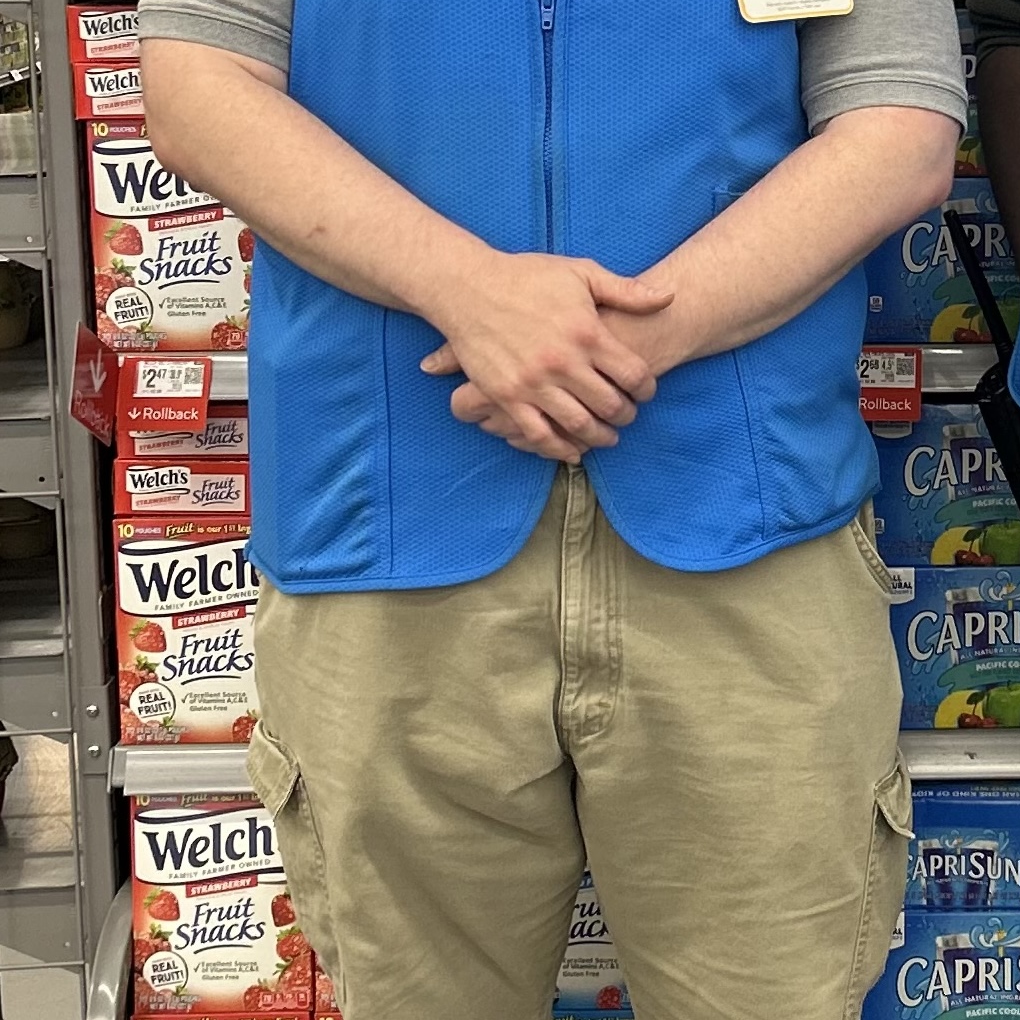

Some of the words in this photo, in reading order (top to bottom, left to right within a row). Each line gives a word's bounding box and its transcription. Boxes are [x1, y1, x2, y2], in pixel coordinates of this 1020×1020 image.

[91, 122, 108, 137] 10
[154, 211, 217, 229] STRAWBERRY
[155, 231, 221, 262] Fruit
[138, 253, 233, 285] Snacks
[115, 296, 143, 309] REAL
[114, 308, 149, 321] FRUIT!
[859, 398, 912, 410] Rollback
[143, 408, 198, 420] Rollback
[205, 420, 238, 436] Fruit
[195, 432, 244, 448] Snacks
[129, 469, 188, 489] Welch's
[202, 477, 235, 493] Fruit
[192, 489, 240, 505] Snacks
[117, 524, 134, 538] 10
[165, 522, 194, 537] Fruit
[126, 548, 260, 602] Welch
[181, 628, 243, 659] Fruit
[162, 649, 255, 681] Snacks
[975, 662, 1008, 671] PACIFIC
[138, 692, 166, 704] REAL
[137, 702, 172, 715] FRUIT!
[142, 817, 275, 871] Welch
[190, 878, 252, 896] STRAWBERRY
[193, 897, 256, 926] Fruit
[174, 918, 266, 950] Snacks
[152, 961, 178, 973] REAL
[151, 971, 185, 984] FRUIT!
[965, 1008, 998, 1018] PACIFIC
